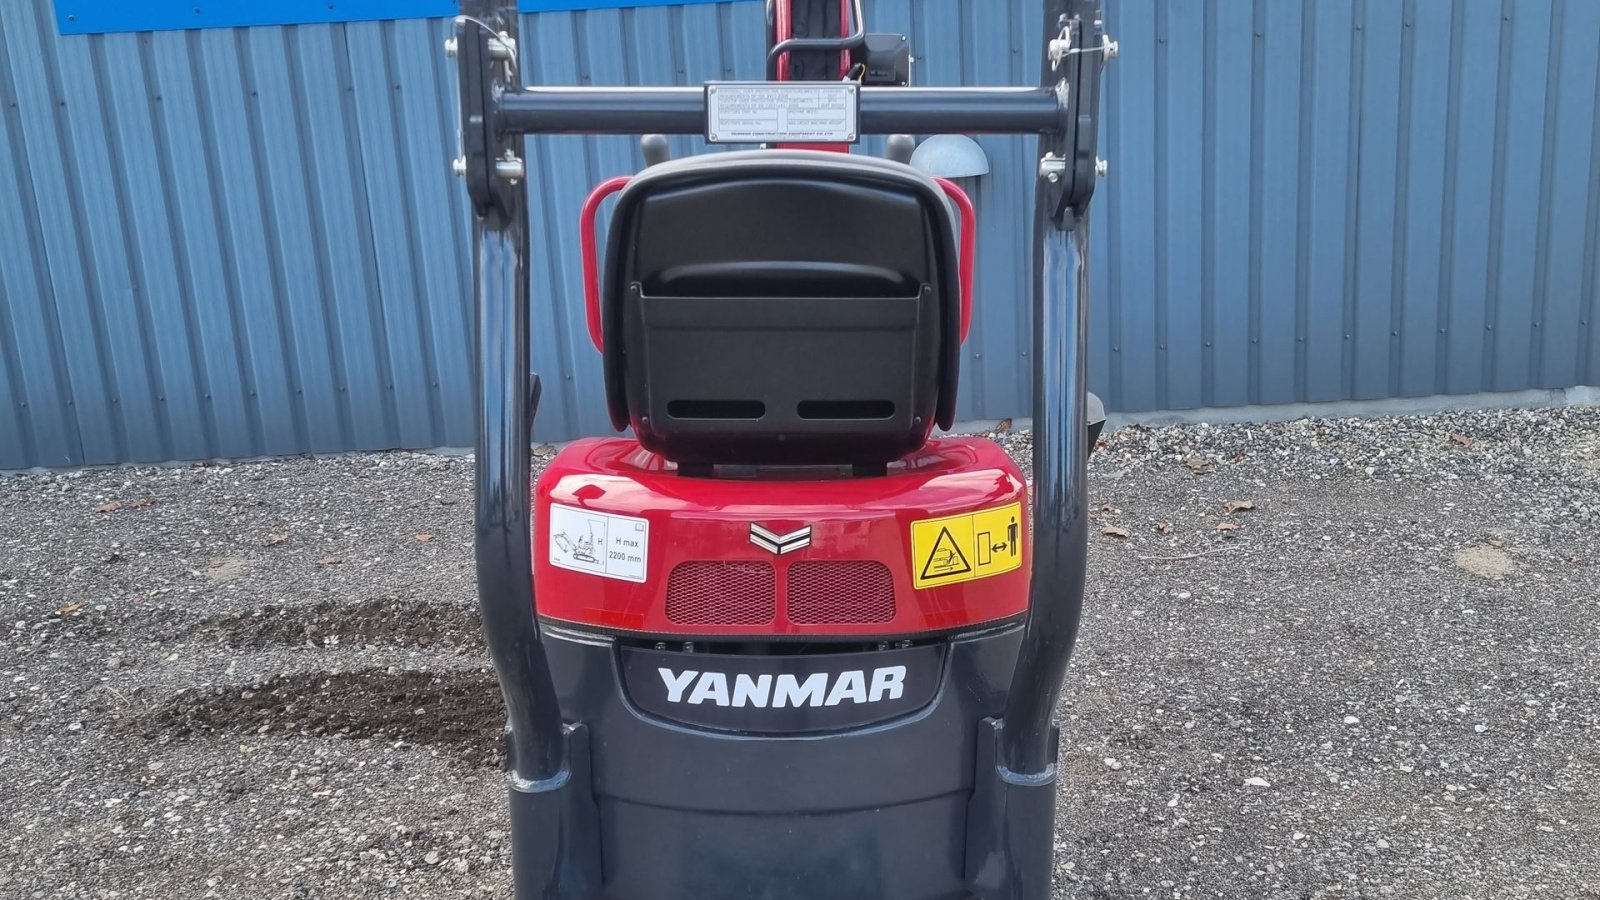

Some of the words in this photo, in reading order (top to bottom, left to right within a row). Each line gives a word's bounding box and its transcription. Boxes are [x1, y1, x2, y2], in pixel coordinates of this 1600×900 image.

[616, 536, 621, 545] H
[623, 539, 639, 548] max
[609, 550, 626, 561] 2200
[627, 555, 642, 563] mm
[657, 665, 907, 708] YANMAR
